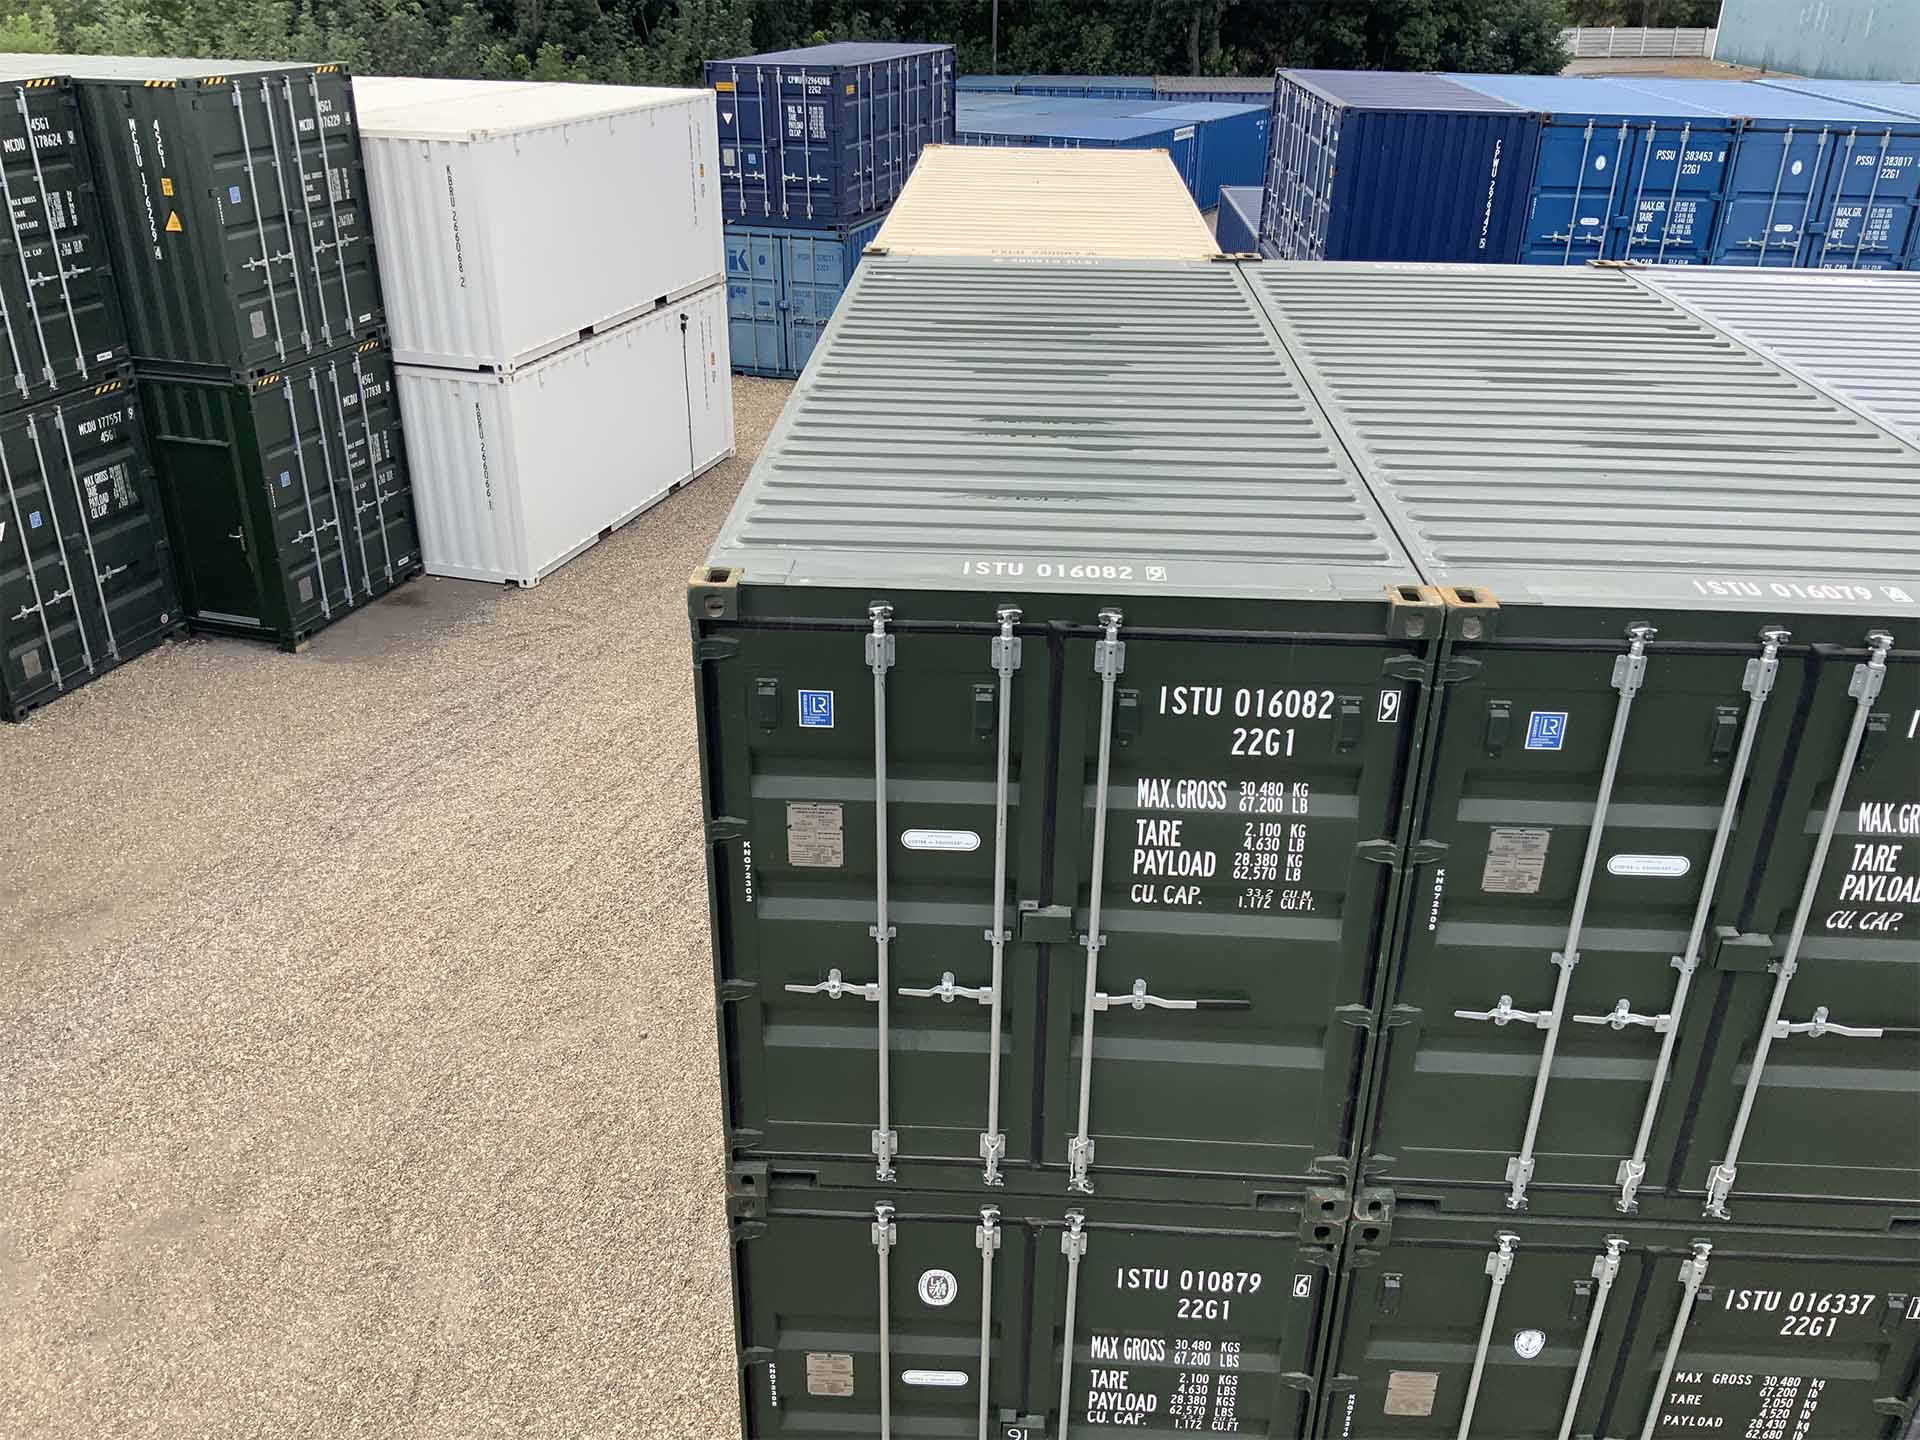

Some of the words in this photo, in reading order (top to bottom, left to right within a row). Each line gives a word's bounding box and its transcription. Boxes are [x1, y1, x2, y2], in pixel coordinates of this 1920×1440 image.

[30, 117, 50, 131] 45G1
[3, 137, 26, 153] MCDU
[34, 132, 63, 149] 178624
[153, 119, 166, 169] 45G1
[1655, 149, 1676, 161] PSSU
[1684, 150, 1713, 162] 383453
[1855, 155, 1876, 166] PSSU
[1883, 156, 1913, 167] 383017
[1681, 163, 1701, 175] 22G1
[1880, 168, 1900, 179] 22G1
[128, 118, 143, 168] MCDU
[141, 172, 157, 242] 176229
[1482, 180, 1496, 236] 296445
[1639, 212, 1654, 223] TARE
[1635, 223, 1648, 233] NET
[1834, 217, 1850, 228] TARE
[1830, 229, 1845, 239] NET
[78, 419, 97, 436] MCDU
[97, 410, 122, 429] 177557
[962, 560, 1024, 576] ISTU
[1036, 563, 1134, 580] 016082
[1693, 578, 1762, 597] ISTU
[1768, 582, 1873, 601] 016079
[1159, 685, 1223, 717] ISTU
[1234, 688, 1336, 720] 016082
[1377, 689, 1401, 723] 9
[1231, 728, 1296, 757] 22G1
[1239, 781, 1284, 798] 30.480
[1292, 782, 1309, 798] KG
[1239, 797, 1283, 813] 67.200
[1292, 797, 1308, 814] LB
[1136, 819, 1183, 848] TARE
[1244, 822, 1281, 838] 2.100
[1290, 823, 1306, 839] KG
[1243, 837, 1280, 852] 4.630
[1288, 837, 1305, 853] LB
[1132, 848, 1217, 878] PAYLOAD
[1234, 852, 1278, 868] 28.380
[1286, 853, 1303, 868] KG
[1850, 844, 1903, 873] TARE
[1232, 866, 1277, 881] 62.570
[1285, 867, 1301, 882] LB
[1131, 884, 1158, 905] CU.
[1163, 885, 1203, 905] CAP.
[1238, 896, 1271, 910] 1.172
[1825, 910, 1853, 930] CU.
[1859, 911, 1904, 931] CAP.
[1117, 1267, 1169, 1290] ISTU
[1180, 1269, 1262, 1294] 010879
[1293, 1273, 1312, 1298] 6
[1177, 1298, 1230, 1321] 22G1
[1725, 1289, 1783, 1311] ISTU
[1789, 1292, 1876, 1315] 016337
[1780, 1315, 1837, 1337] 22G1
[1090, 1335, 1119, 1360] MAX
[1123, 1336, 1166, 1361] GROSS
[1175, 1338, 1212, 1352] 30.480
[1220, 1340, 1241, 1353] KGS
[1173, 1352, 1211, 1366] 67.200
[1219, 1354, 1240, 1368] LBS
[1090, 1369, 1129, 1391] TARE
[1179, 1373, 1210, 1385] 2.100
[1218, 1374, 1239, 1386] KGS
[1675, 1372, 1703, 1384] MAX
[1712, 1374, 1753, 1386] GROSS
[1763, 1375, 1802, 1388] 30.480
[1811, 1377, 1826, 1391] kg
[1177, 1384, 1208, 1396] 4.630
[1217, 1385, 1237, 1397] LBS
[1759, 1387, 1798, 1398] 67.200
[1807, 1387, 1819, 1399] lb
[1087, 1390, 1158, 1413] PAYLOAD
[1170, 1394, 1207, 1406] 28.380
[1215, 1395, 1236, 1408] KGS
[1670, 1393, 1703, 1406] TARE
[1762, 1398, 1794, 1409] 2.050
[1803, 1399, 1817, 1412] kg
[1087, 1410, 1109, 1425] CU.
[1113, 1412, 1148, 1426] CAP.
[1169, 1405, 1206, 1418] 62.570
[1214, 1406, 1234, 1418] LBS
[1759, 1409, 1791, 1420] 4.520
[1800, 1409, 1811, 1420] lb
[1663, 1414, 1724, 1428] PAYLOAD
[1748, 1419, 1787, 1430] 28.430
[1796, 1420, 1810, 1433] kg
[1745, 1430, 1783, 1440] 62.680
[1792, 1430, 1804, 1440] lb
